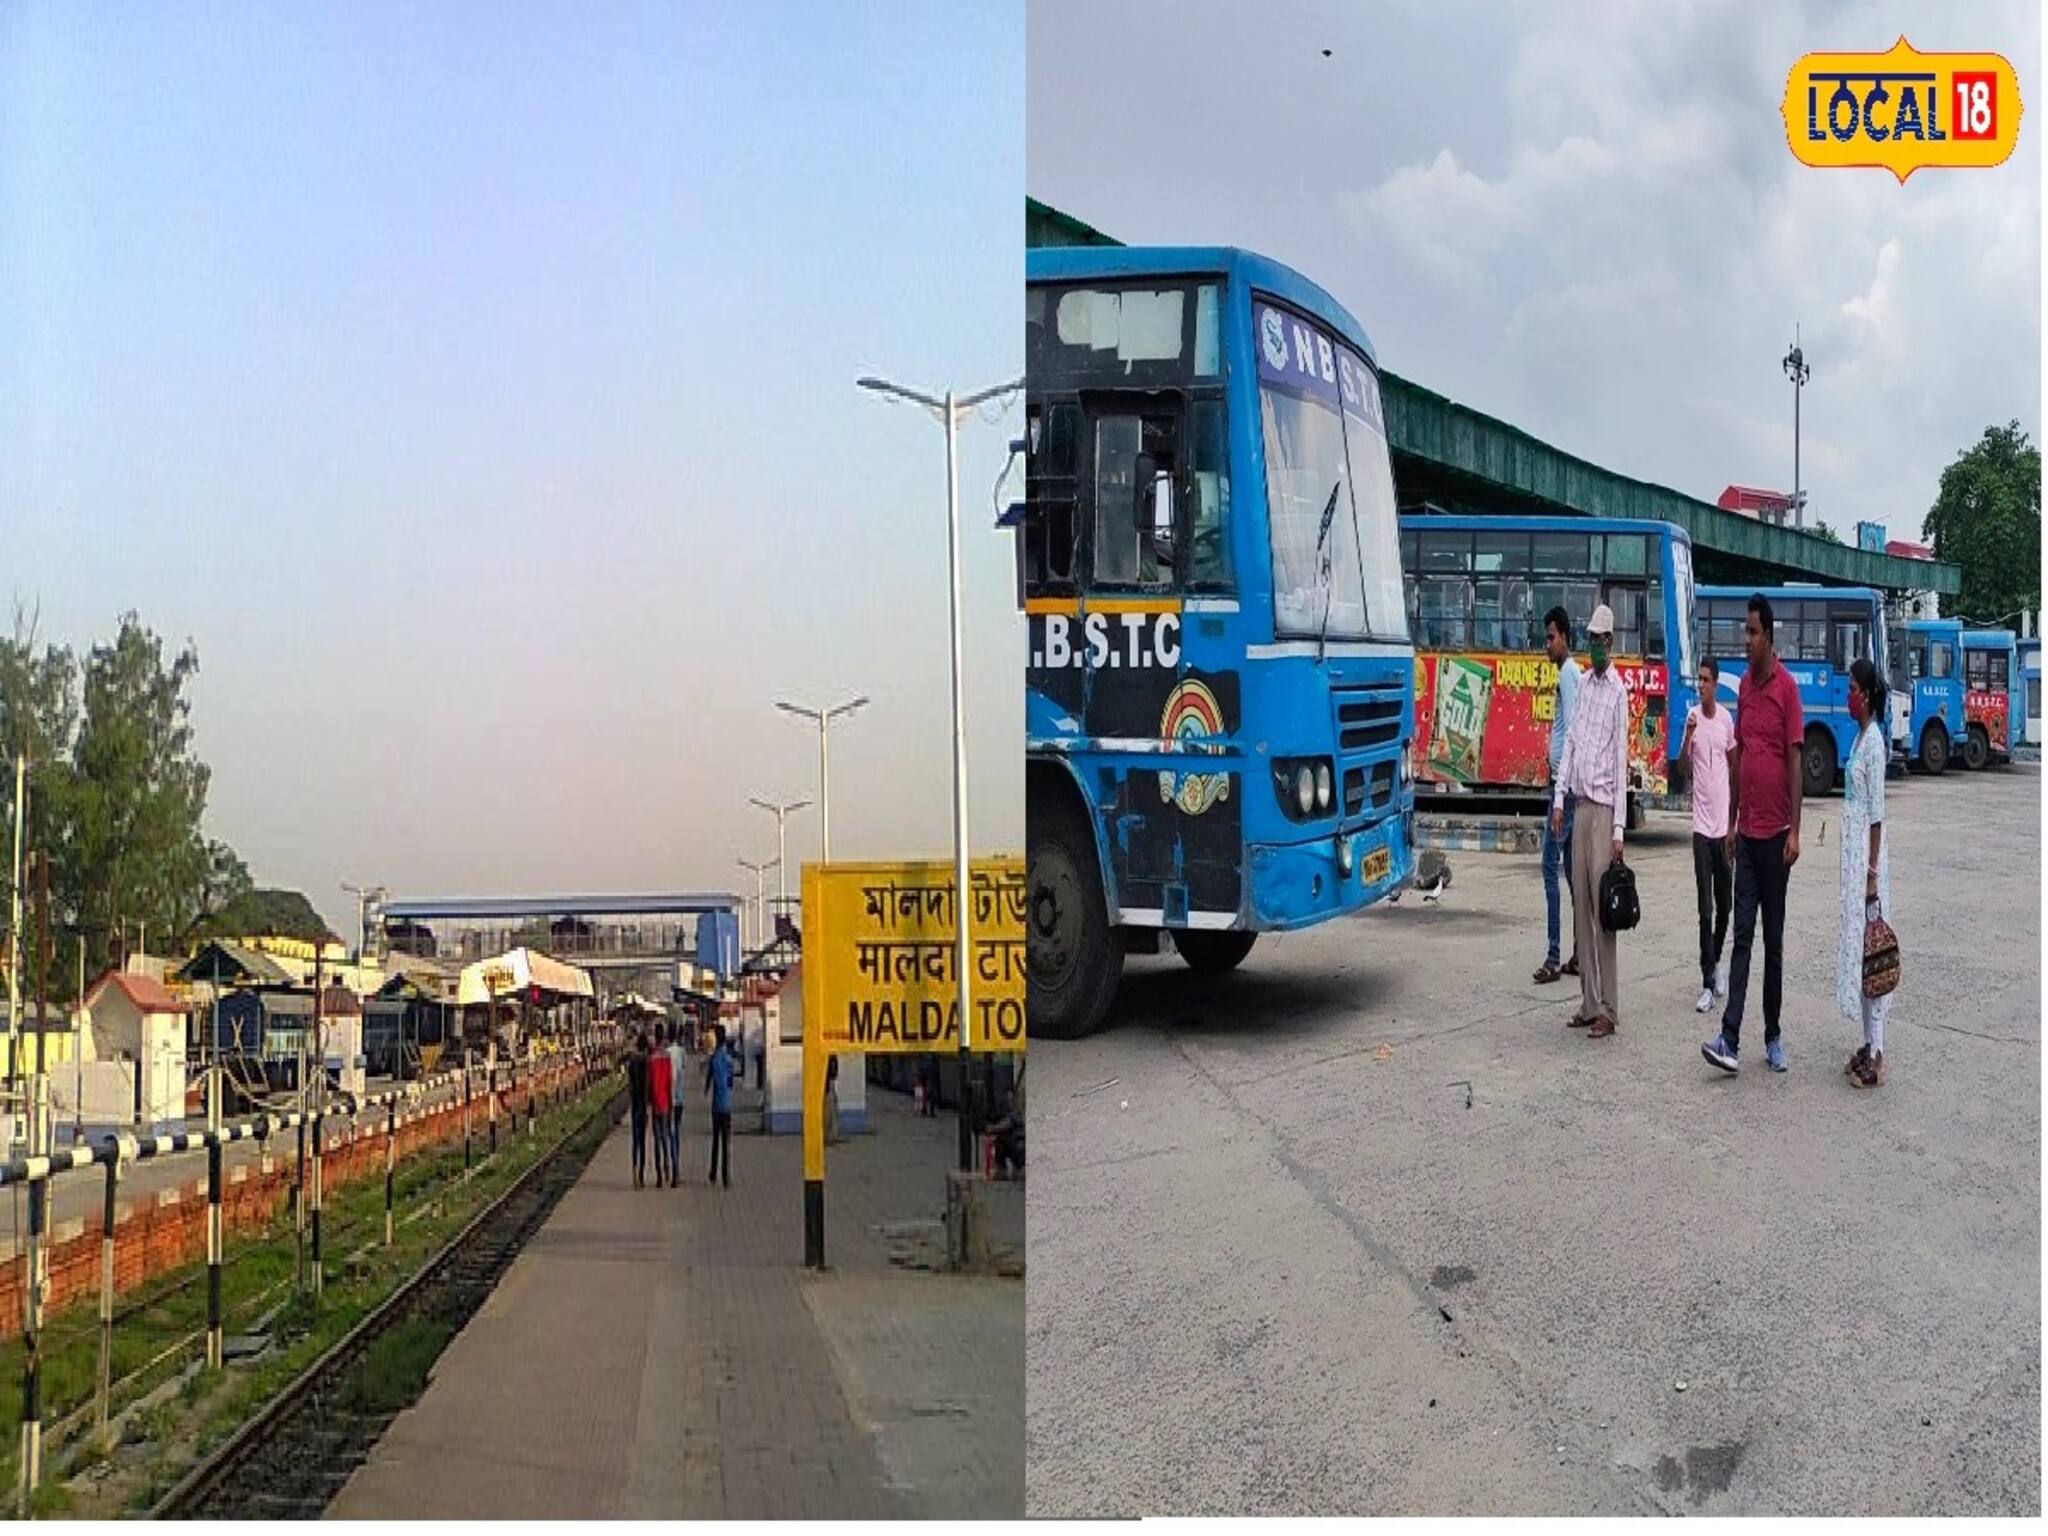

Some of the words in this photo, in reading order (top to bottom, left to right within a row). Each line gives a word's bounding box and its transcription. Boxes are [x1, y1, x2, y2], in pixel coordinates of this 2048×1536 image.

[1026, 612, 1181, 668] .B.S.T.C
[856, 940, 956, 985] मालदा
[849, 1001, 959, 1042] MALDA
[977, 998, 1026, 1040] TO
